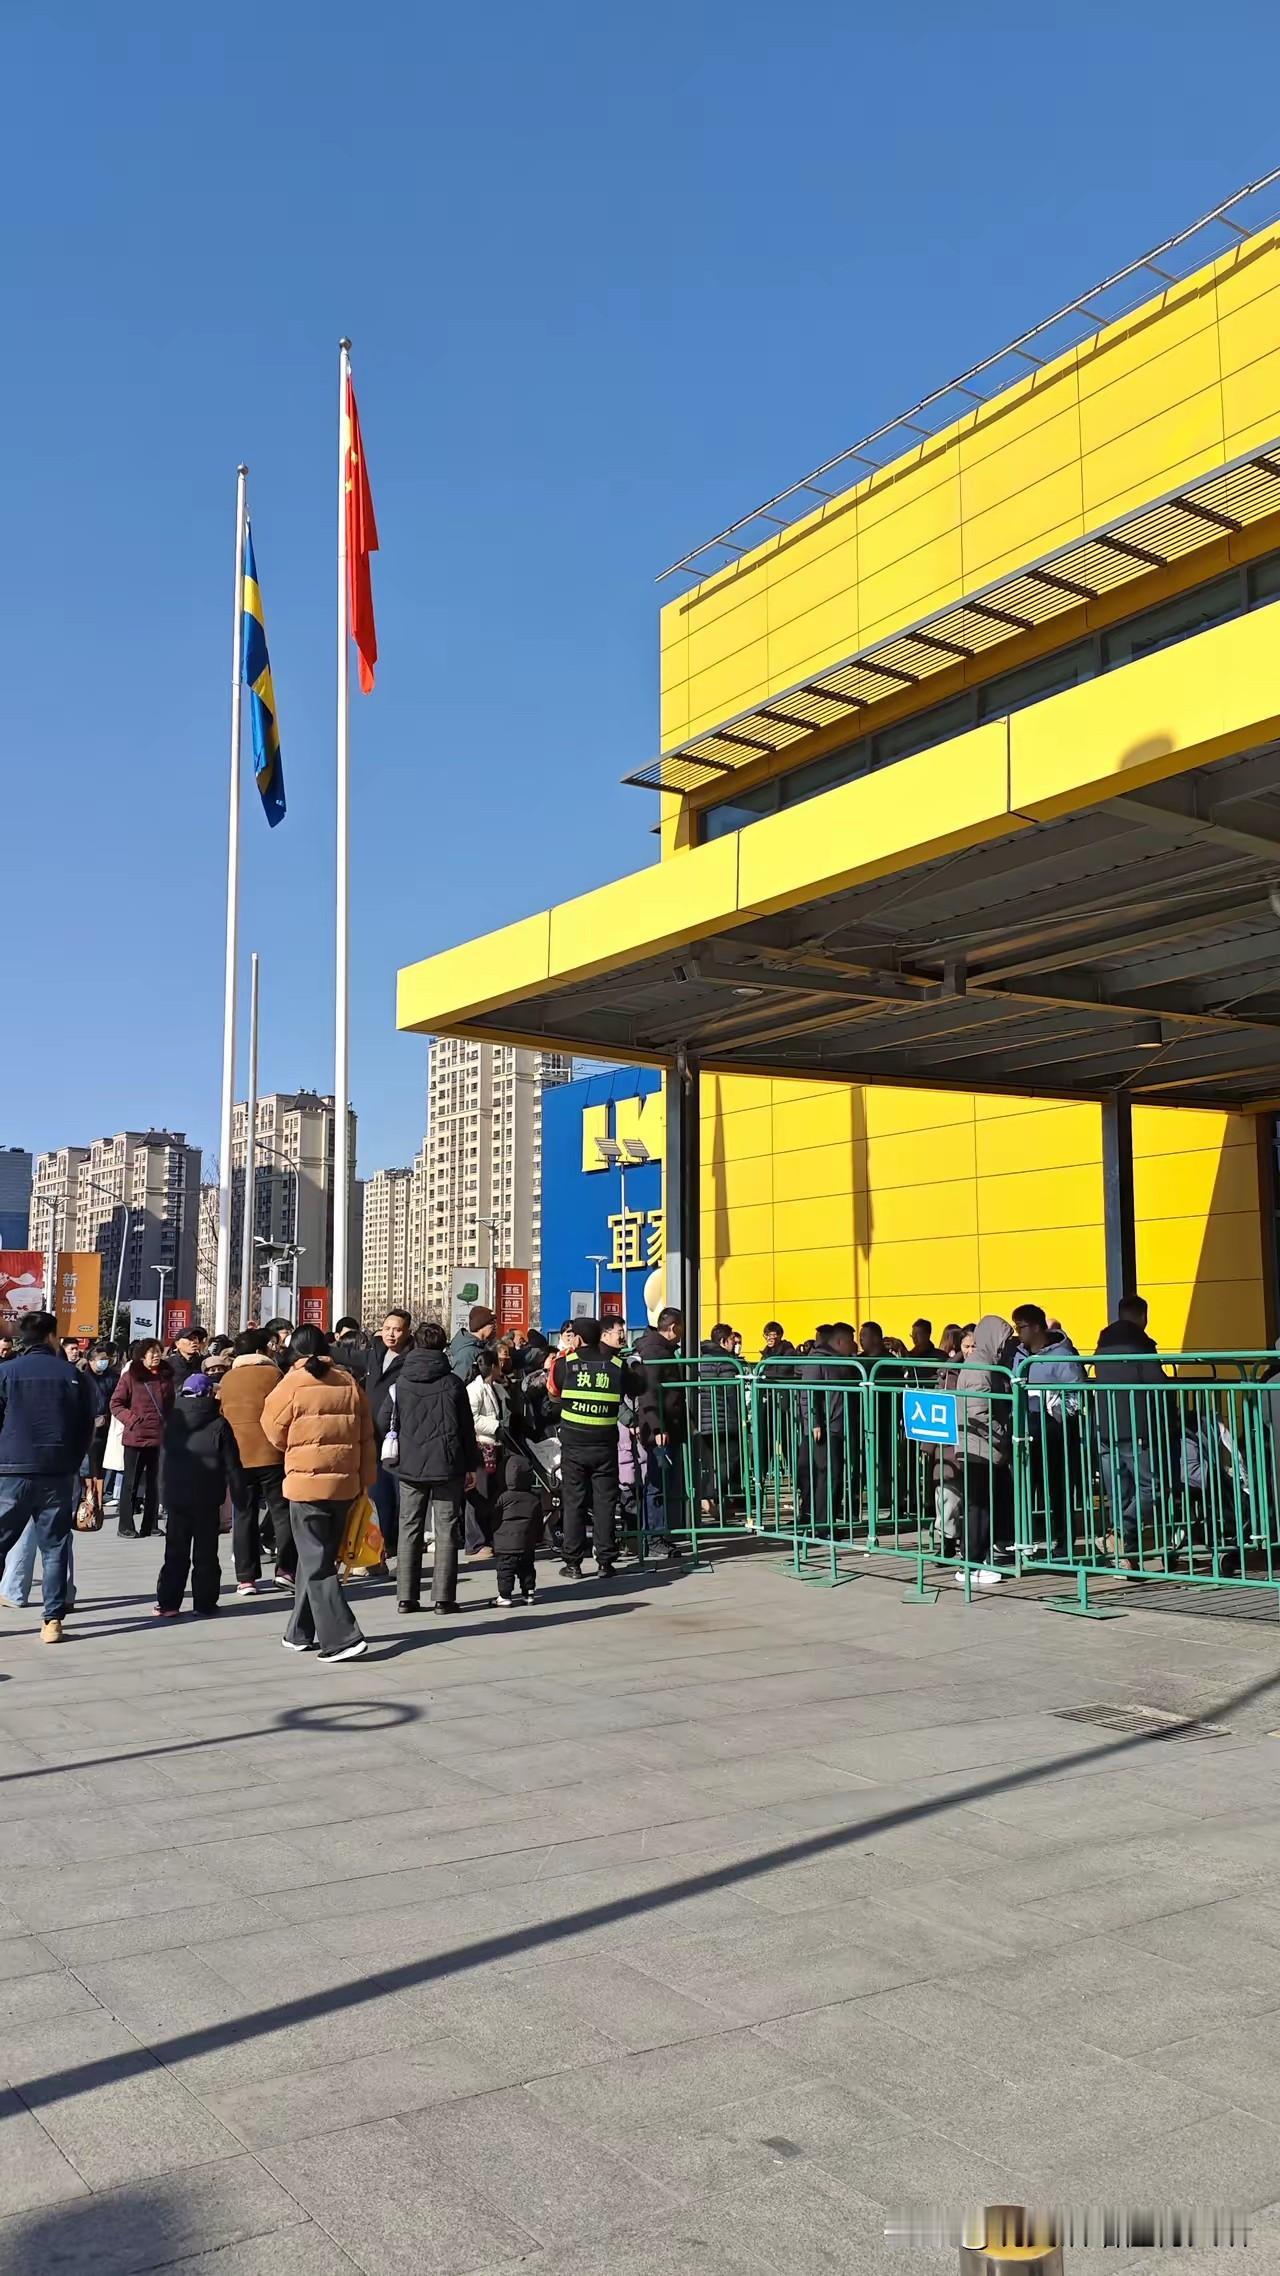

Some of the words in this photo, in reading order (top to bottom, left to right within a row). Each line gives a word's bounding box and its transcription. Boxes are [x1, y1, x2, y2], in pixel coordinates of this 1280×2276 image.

[62, 1273, 78, 1305] 新品
[577, 1371, 610, 1389] 执勤
[572, 1401, 609, 1414] ZHIQIN
[911, 1401, 947, 1425] 入口
